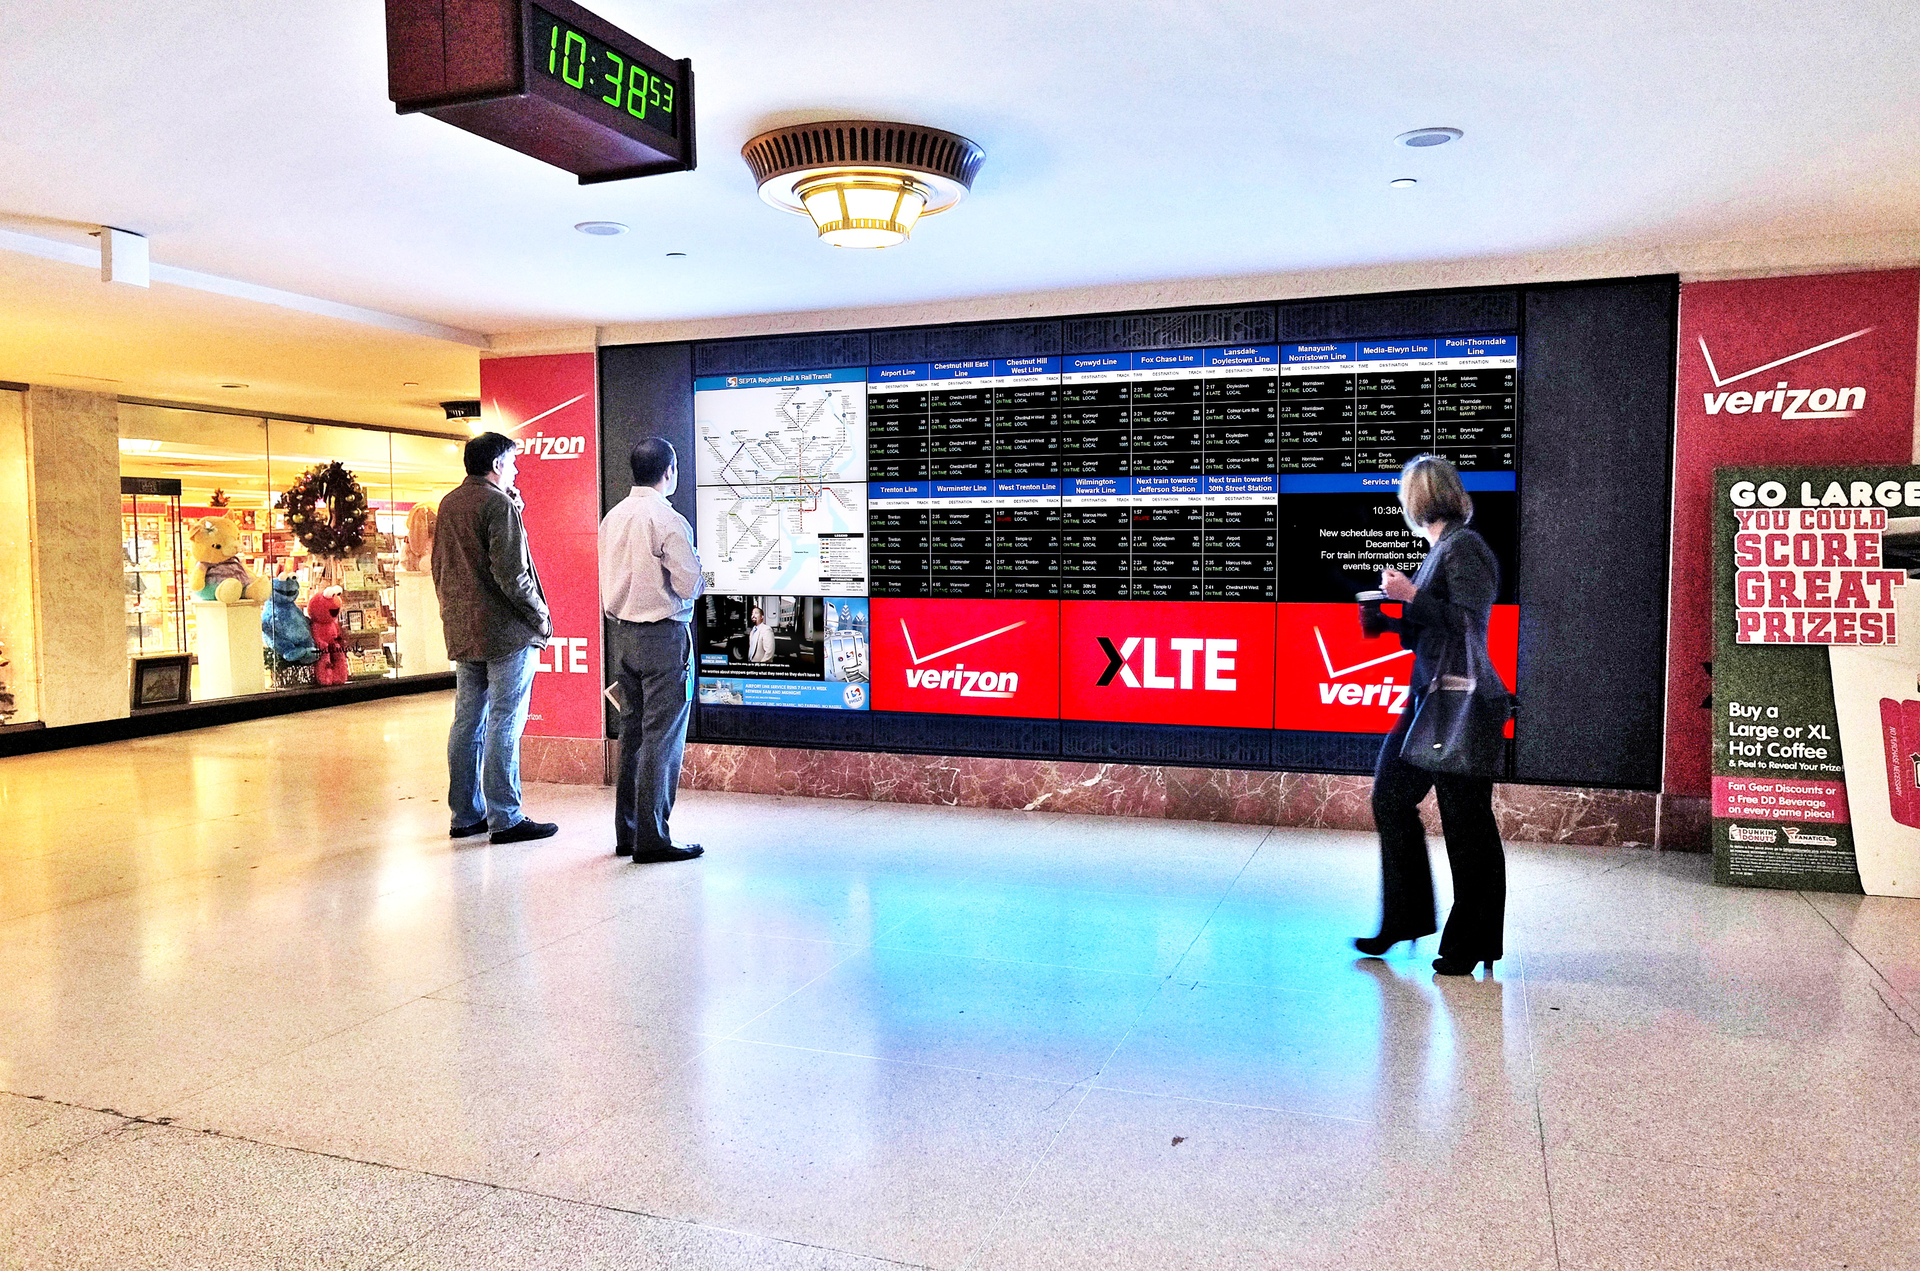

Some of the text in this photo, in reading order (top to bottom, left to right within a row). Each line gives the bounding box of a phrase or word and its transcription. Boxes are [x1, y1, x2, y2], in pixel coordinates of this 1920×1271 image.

[549, 26, 674, 119] 10:38 53
[1298, 344, 1337, 353] Manayunk-
[1446, 338, 1506, 346] Paoli-Thorndale
[1074, 359, 1101, 367] Cynwyd
[1212, 357, 1253, 366] Doylestown
[758, 376, 782, 384] Regional
[1703, 382, 1866, 420] verizon
[515, 432, 586, 460] erizon
[1730, 481, 1920, 507] GO LARGE
[1372, 506, 1406, 514] 10:38A
[1734, 509, 1885, 531] YOU COULD
[1320, 529, 1339, 537] New
[1340, 529, 1383, 537] schedules
[1402, 528, 1410, 537] in
[1366, 540, 1410, 548] December
[1735, 533, 1880, 567] SCORE
[1321, 550, 1335, 559] For
[1337, 551, 1356, 559] train
[1358, 551, 1404, 559] information
[1373, 564, 1383, 572] go
[1737, 570, 1904, 608] GREAT
[1736, 611, 1896, 644] PRIZES!
[532, 637, 588, 673] LTE
[905, 665, 1018, 698] verizon
[1319, 677, 1411, 714] veriz
[1729, 702, 1778, 721] Buy a
[1729, 722, 1831, 741] Large or XL
[1729, 741, 1827, 759] Hot Coffee
[1738, 760, 1756, 768] Peel
[1769, 761, 1798, 770] Reveal
[1799, 762, 1818, 771] Your
[1728, 782, 1746, 791] Fan
[1748, 782, 1773, 792] Gear
[1775, 784, 1823, 794] Discounts
[1737, 795, 1758, 804] Free
[1761, 796, 1776, 805] DD
[1779, 797, 1826, 809] Beverage
[1743, 807, 1770, 817] every
[1772, 809, 1802, 818] game
[1804, 809, 1834, 819] piece!
